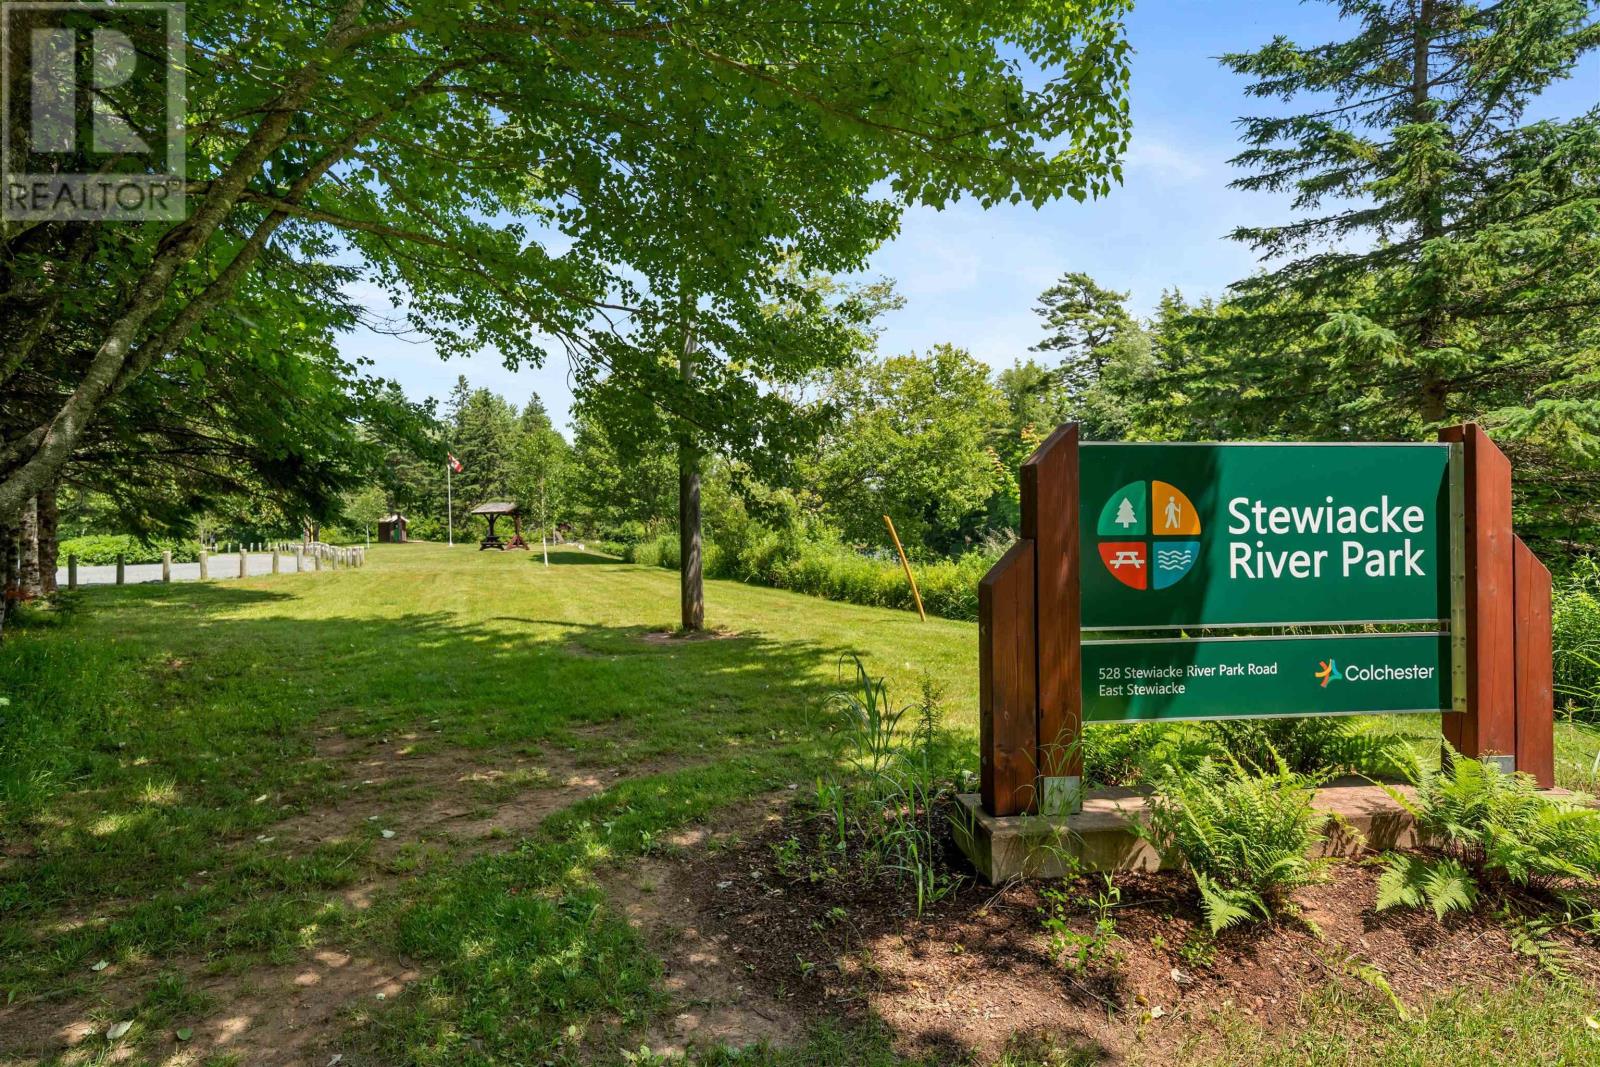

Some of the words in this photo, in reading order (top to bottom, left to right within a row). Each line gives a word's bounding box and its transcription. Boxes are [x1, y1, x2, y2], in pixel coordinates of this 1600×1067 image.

[1228, 495, 1425, 535] Stewiacke
[1229, 540, 1328, 579] River
[1342, 539, 1426, 577] Park
[1098, 667, 1121, 680] 528
[1124, 665, 1183, 679] Stewiacke
[1186, 664, 1216, 677] River
[1219, 663, 1245, 676] Park
[1248, 662, 1278, 675] Road
[1345, 664, 1434, 682] Colchester
[1098, 683, 1123, 697] East
[1126, 682, 1186, 696] Stewiacke
